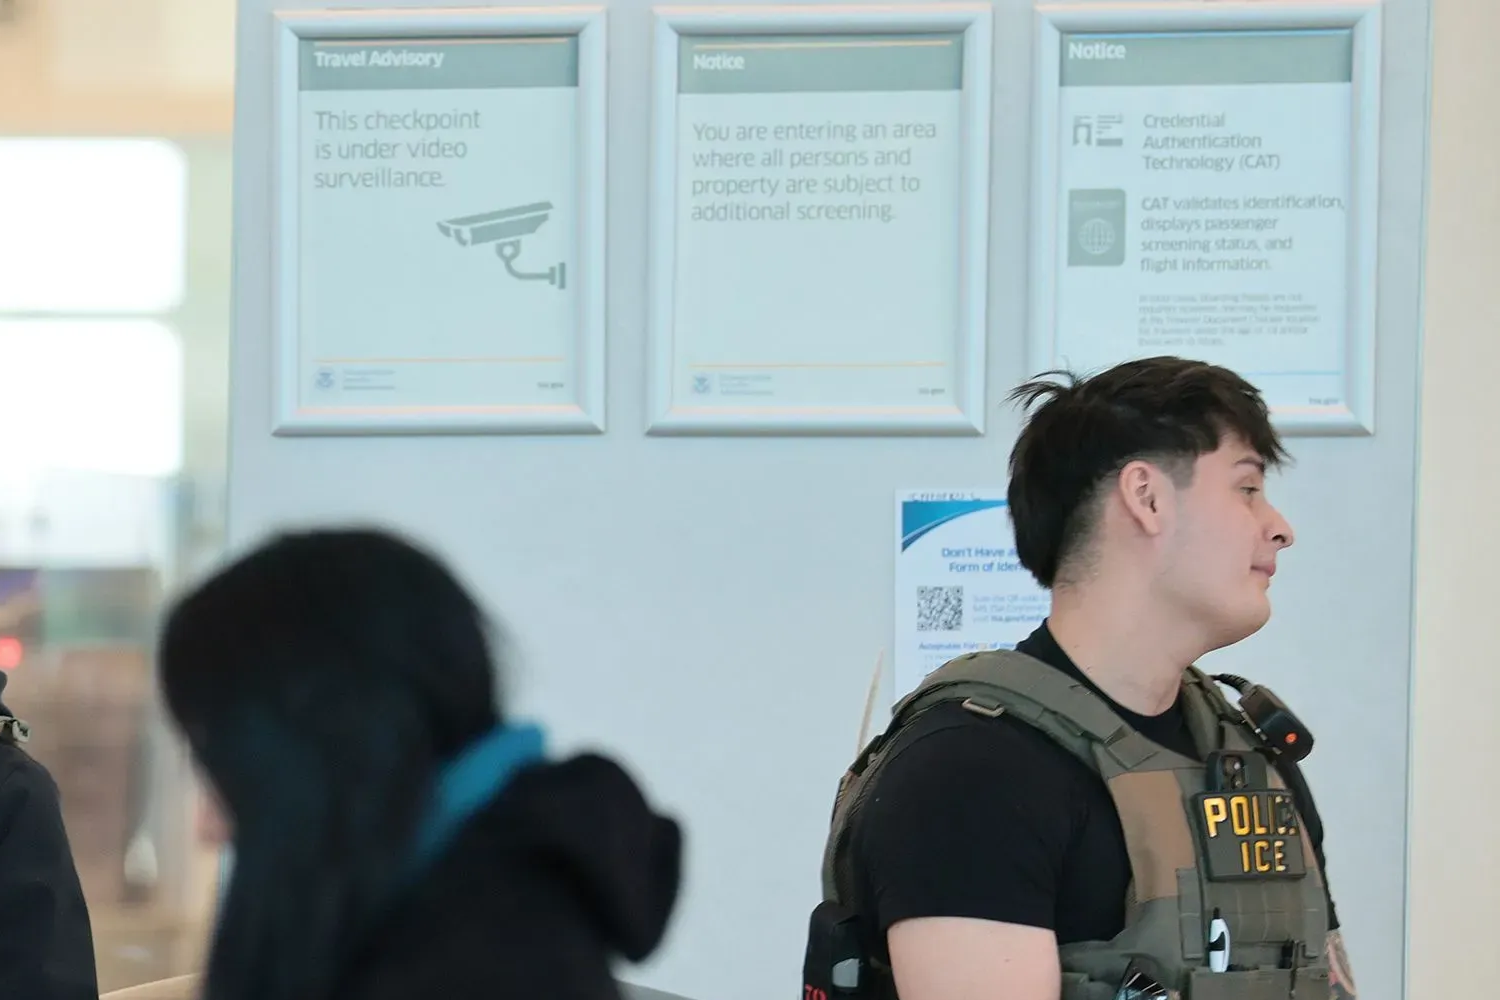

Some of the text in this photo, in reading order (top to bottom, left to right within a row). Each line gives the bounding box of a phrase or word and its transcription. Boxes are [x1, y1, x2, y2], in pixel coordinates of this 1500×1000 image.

[313, 49, 444, 69] Travel Advisory
[1068, 41, 1126, 59] Notice
[693, 53, 745, 70] Notice
[315, 109, 481, 133] This checkpoint
[1143, 113, 1225, 129] Credential
[693, 120, 937, 143] You are entering an area
[315, 138, 467, 160] is under video
[1143, 133, 1262, 150] Authentication
[693, 147, 912, 169] where all persons and
[1143, 153, 1280, 173] Technology (CAT)
[314, 167, 445, 188] surveillance.
[691, 173, 920, 197] property are subject to
[691, 200, 895, 223] additional screening.
[1141, 196, 1169, 211] CAT
[1173, 195, 1240, 211] validates
[1243, 194, 1344, 213] identification,
[1140, 215, 1279, 232] displays passenger
[1140, 236, 1293, 254] screening status, and
[1140, 256, 1273, 275] flight information.
[941, 547, 972, 558] Don't
[975, 547, 1006, 558] Have
[949, 561, 1026, 573] Form of Iden
[1241, 840, 1286, 873] ICE
